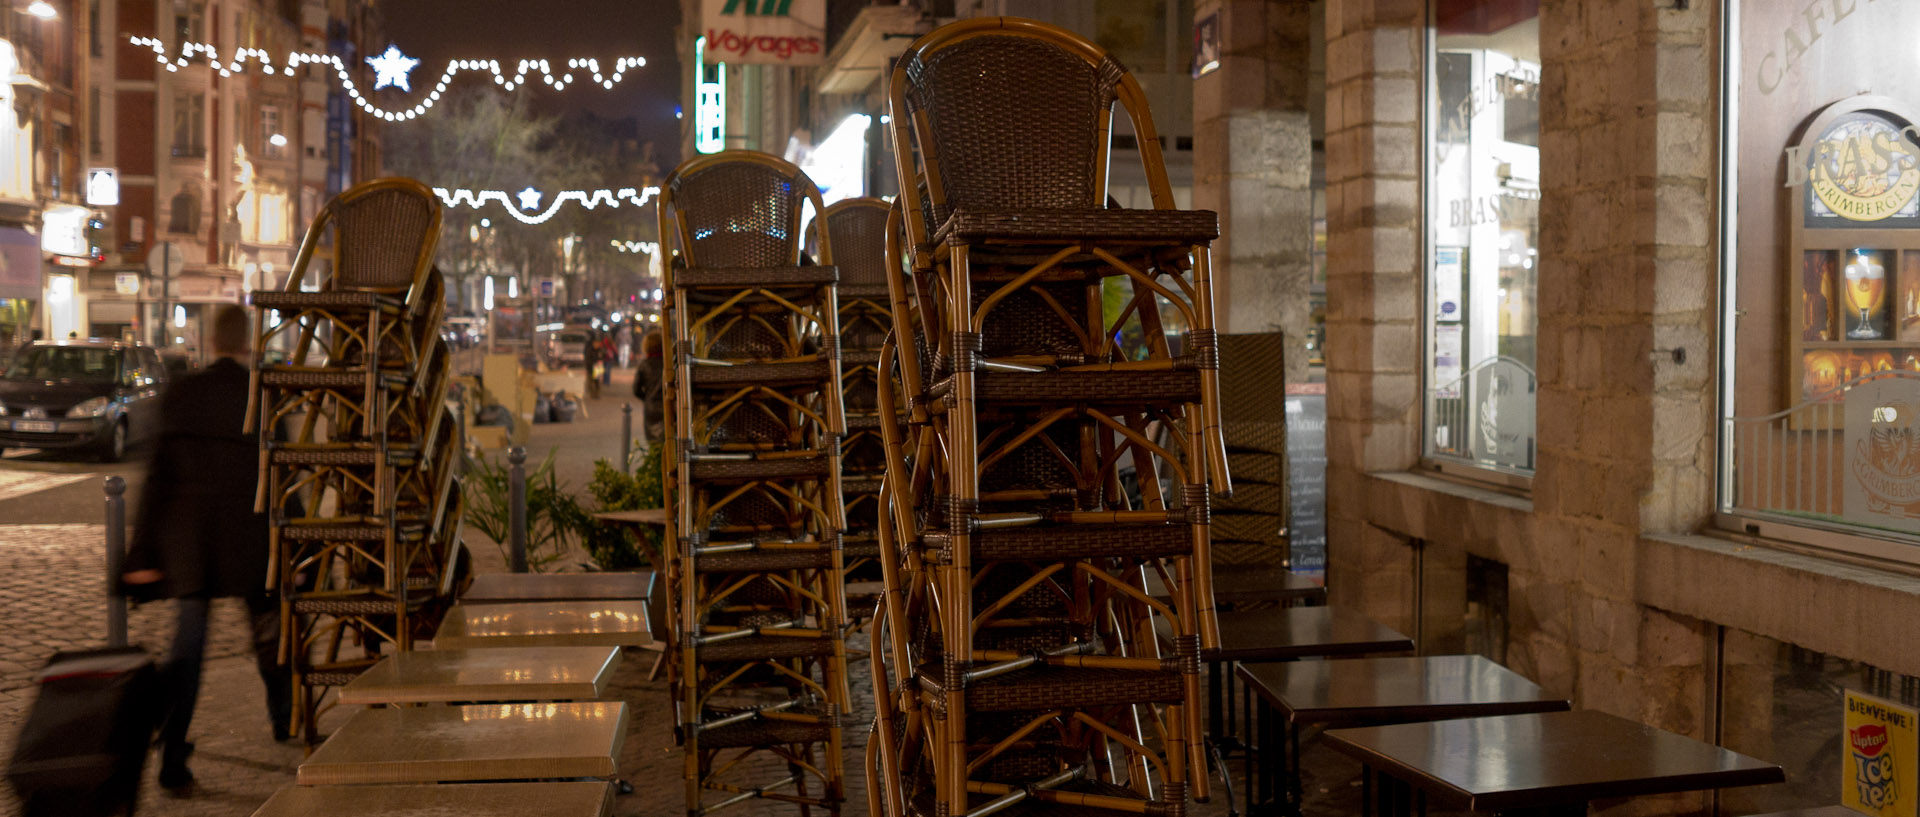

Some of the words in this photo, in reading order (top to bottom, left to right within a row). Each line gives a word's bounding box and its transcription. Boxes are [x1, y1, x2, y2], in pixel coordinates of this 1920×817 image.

[708, 29, 819, 59] Voyages
[1817, 179, 1915, 216] GRIMBERGEN
[1849, 698, 1907, 729] BIENVENUE
[1853, 733, 1886, 749] Lipton
